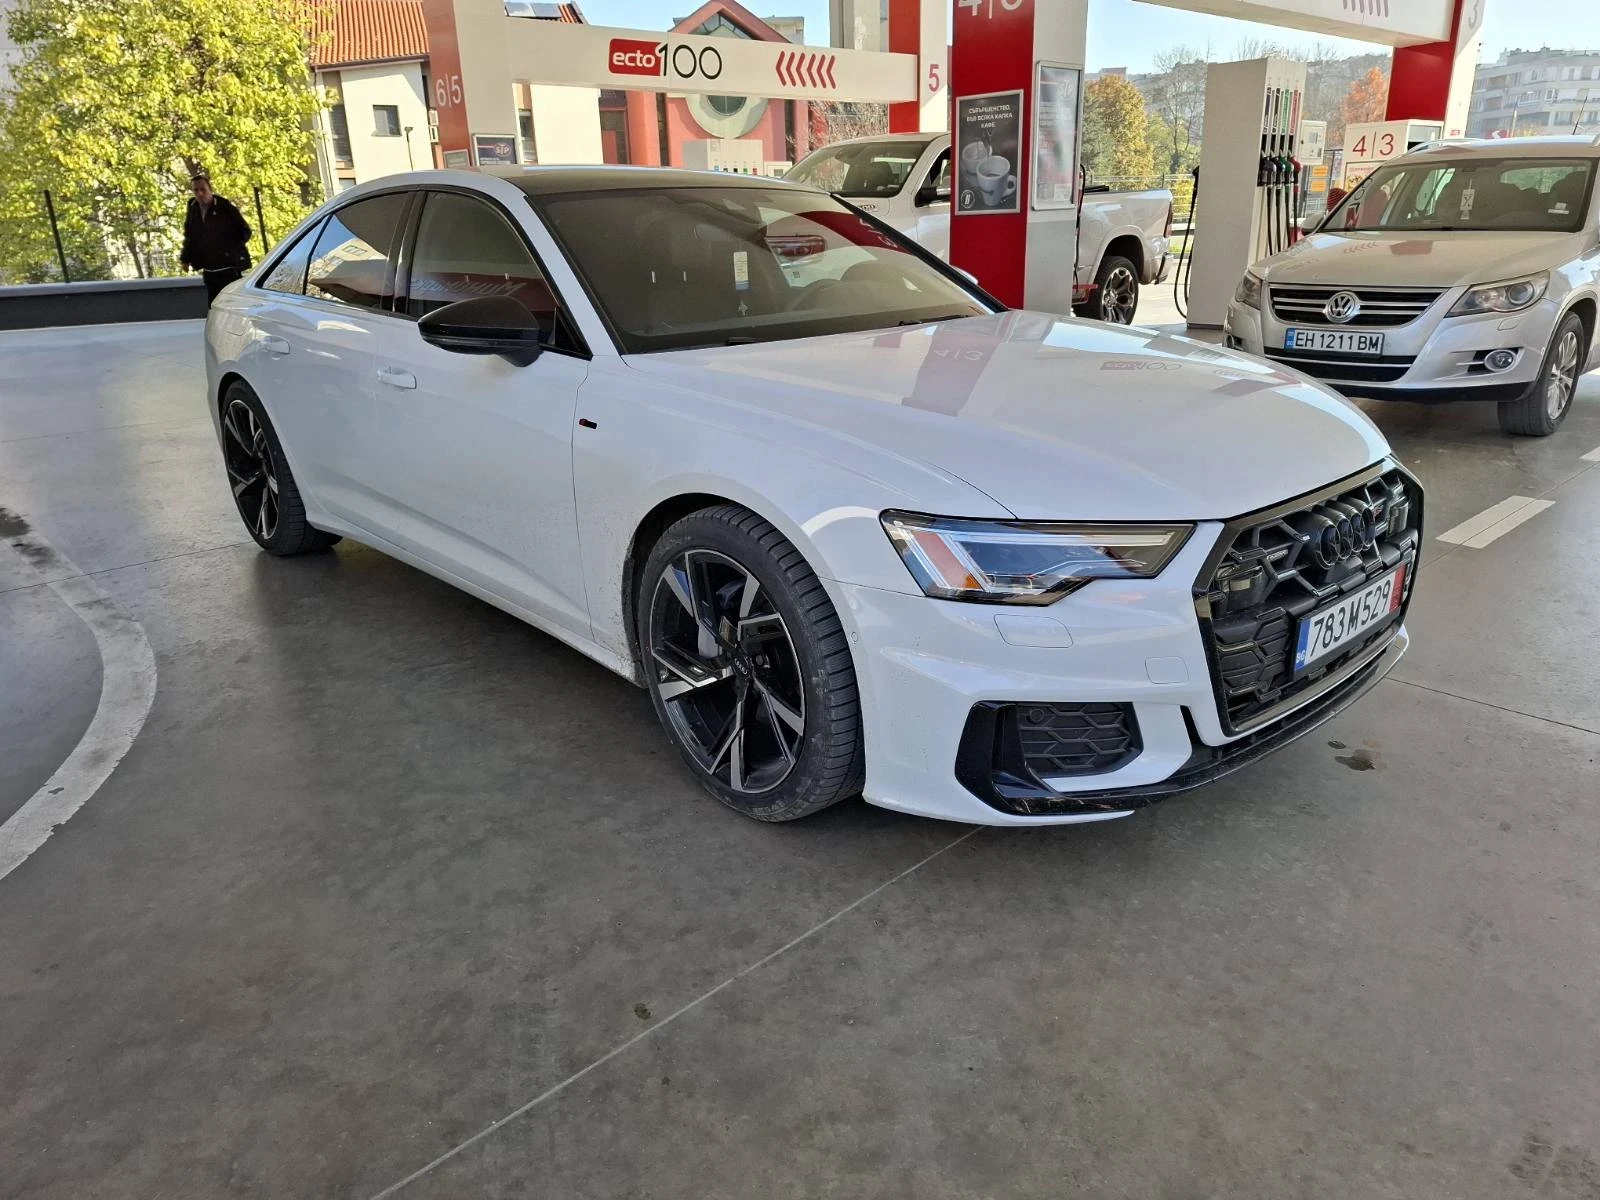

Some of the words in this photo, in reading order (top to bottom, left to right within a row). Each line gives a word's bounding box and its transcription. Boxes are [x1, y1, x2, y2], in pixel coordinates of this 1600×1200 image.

[928, 63, 940, 92] 5
[495, 143, 510, 155] STP
[1295, 332, 1315, 348] EH
[1319, 333, 1354, 351] 1211
[1357, 335, 1380, 352] BM
